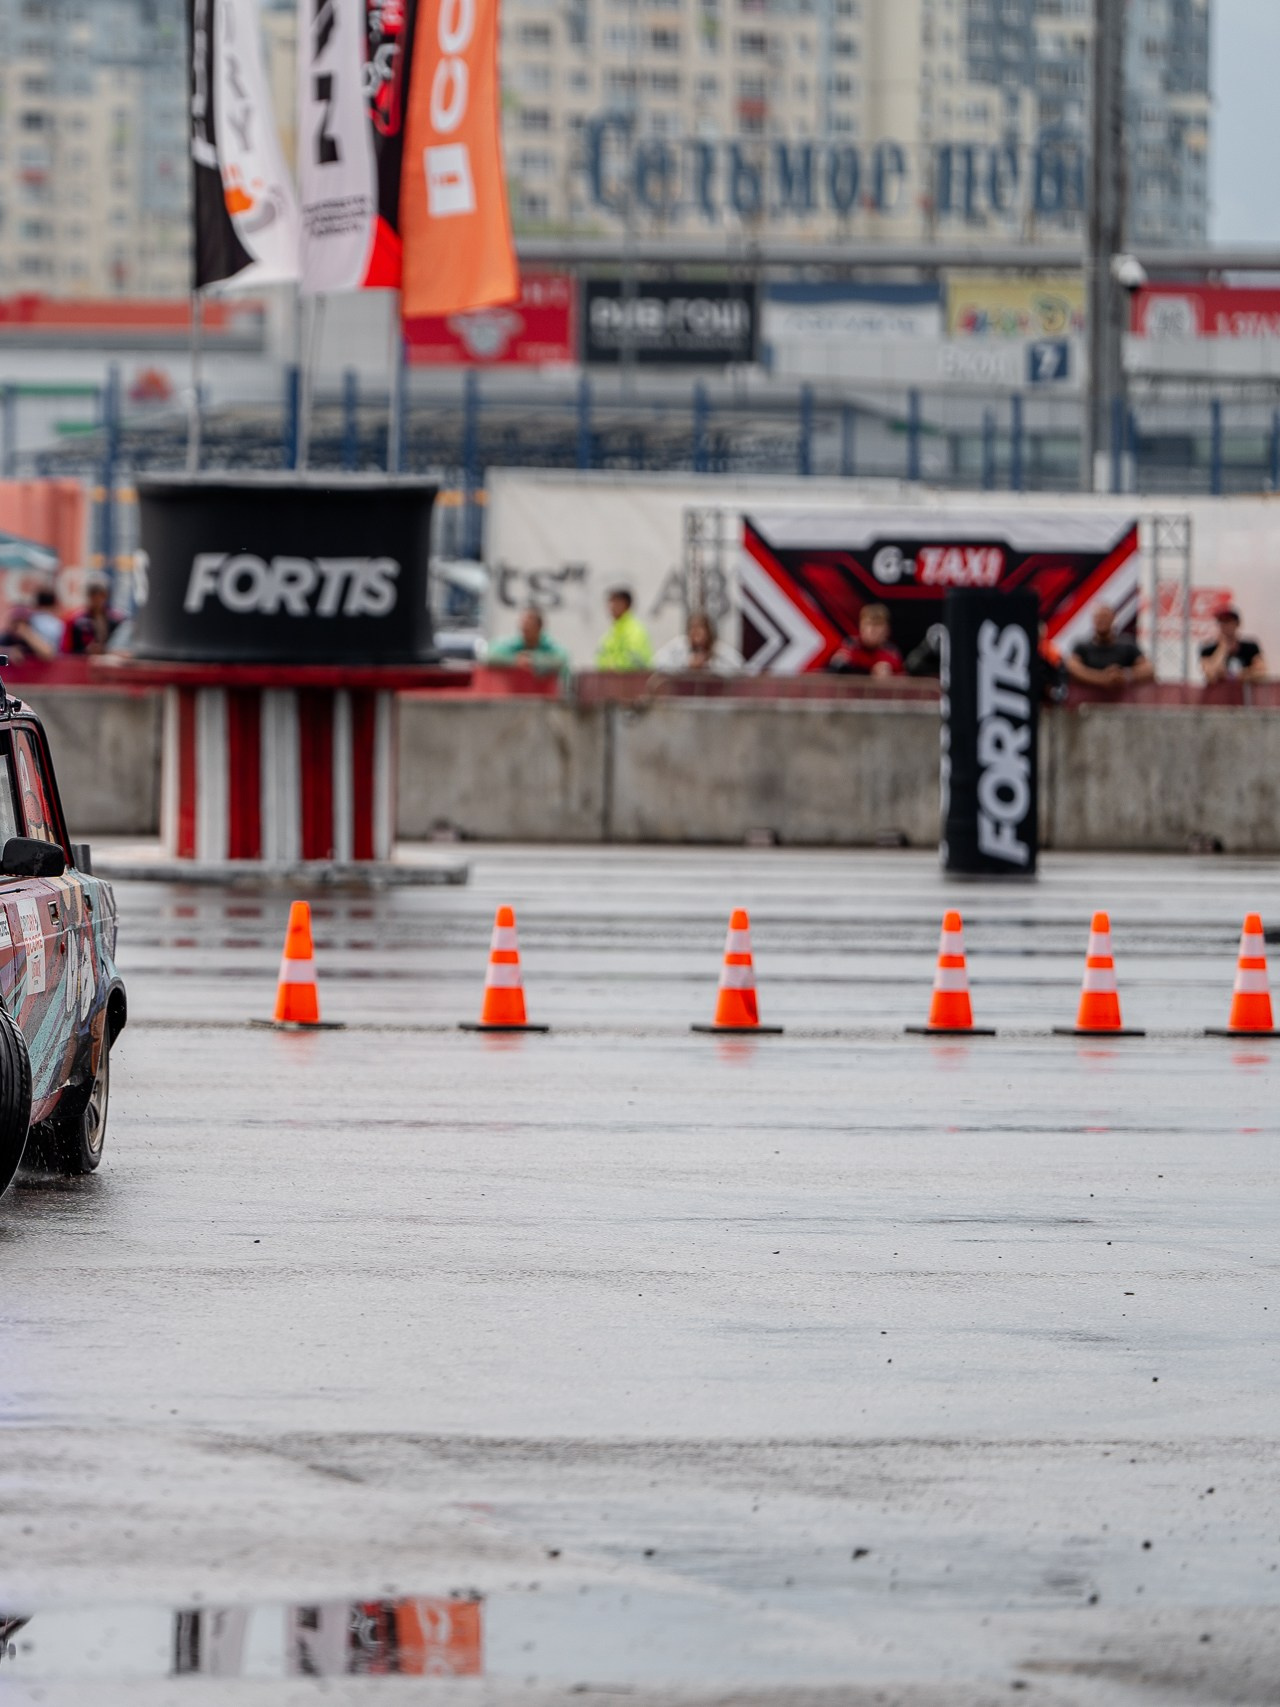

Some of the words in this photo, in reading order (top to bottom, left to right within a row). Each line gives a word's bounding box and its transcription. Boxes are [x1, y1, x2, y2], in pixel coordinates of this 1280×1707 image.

[935, 122, 1088, 222] неб
[184, 553, 400, 616] FORTIS
[977, 620, 1032, 866] FORTIS
